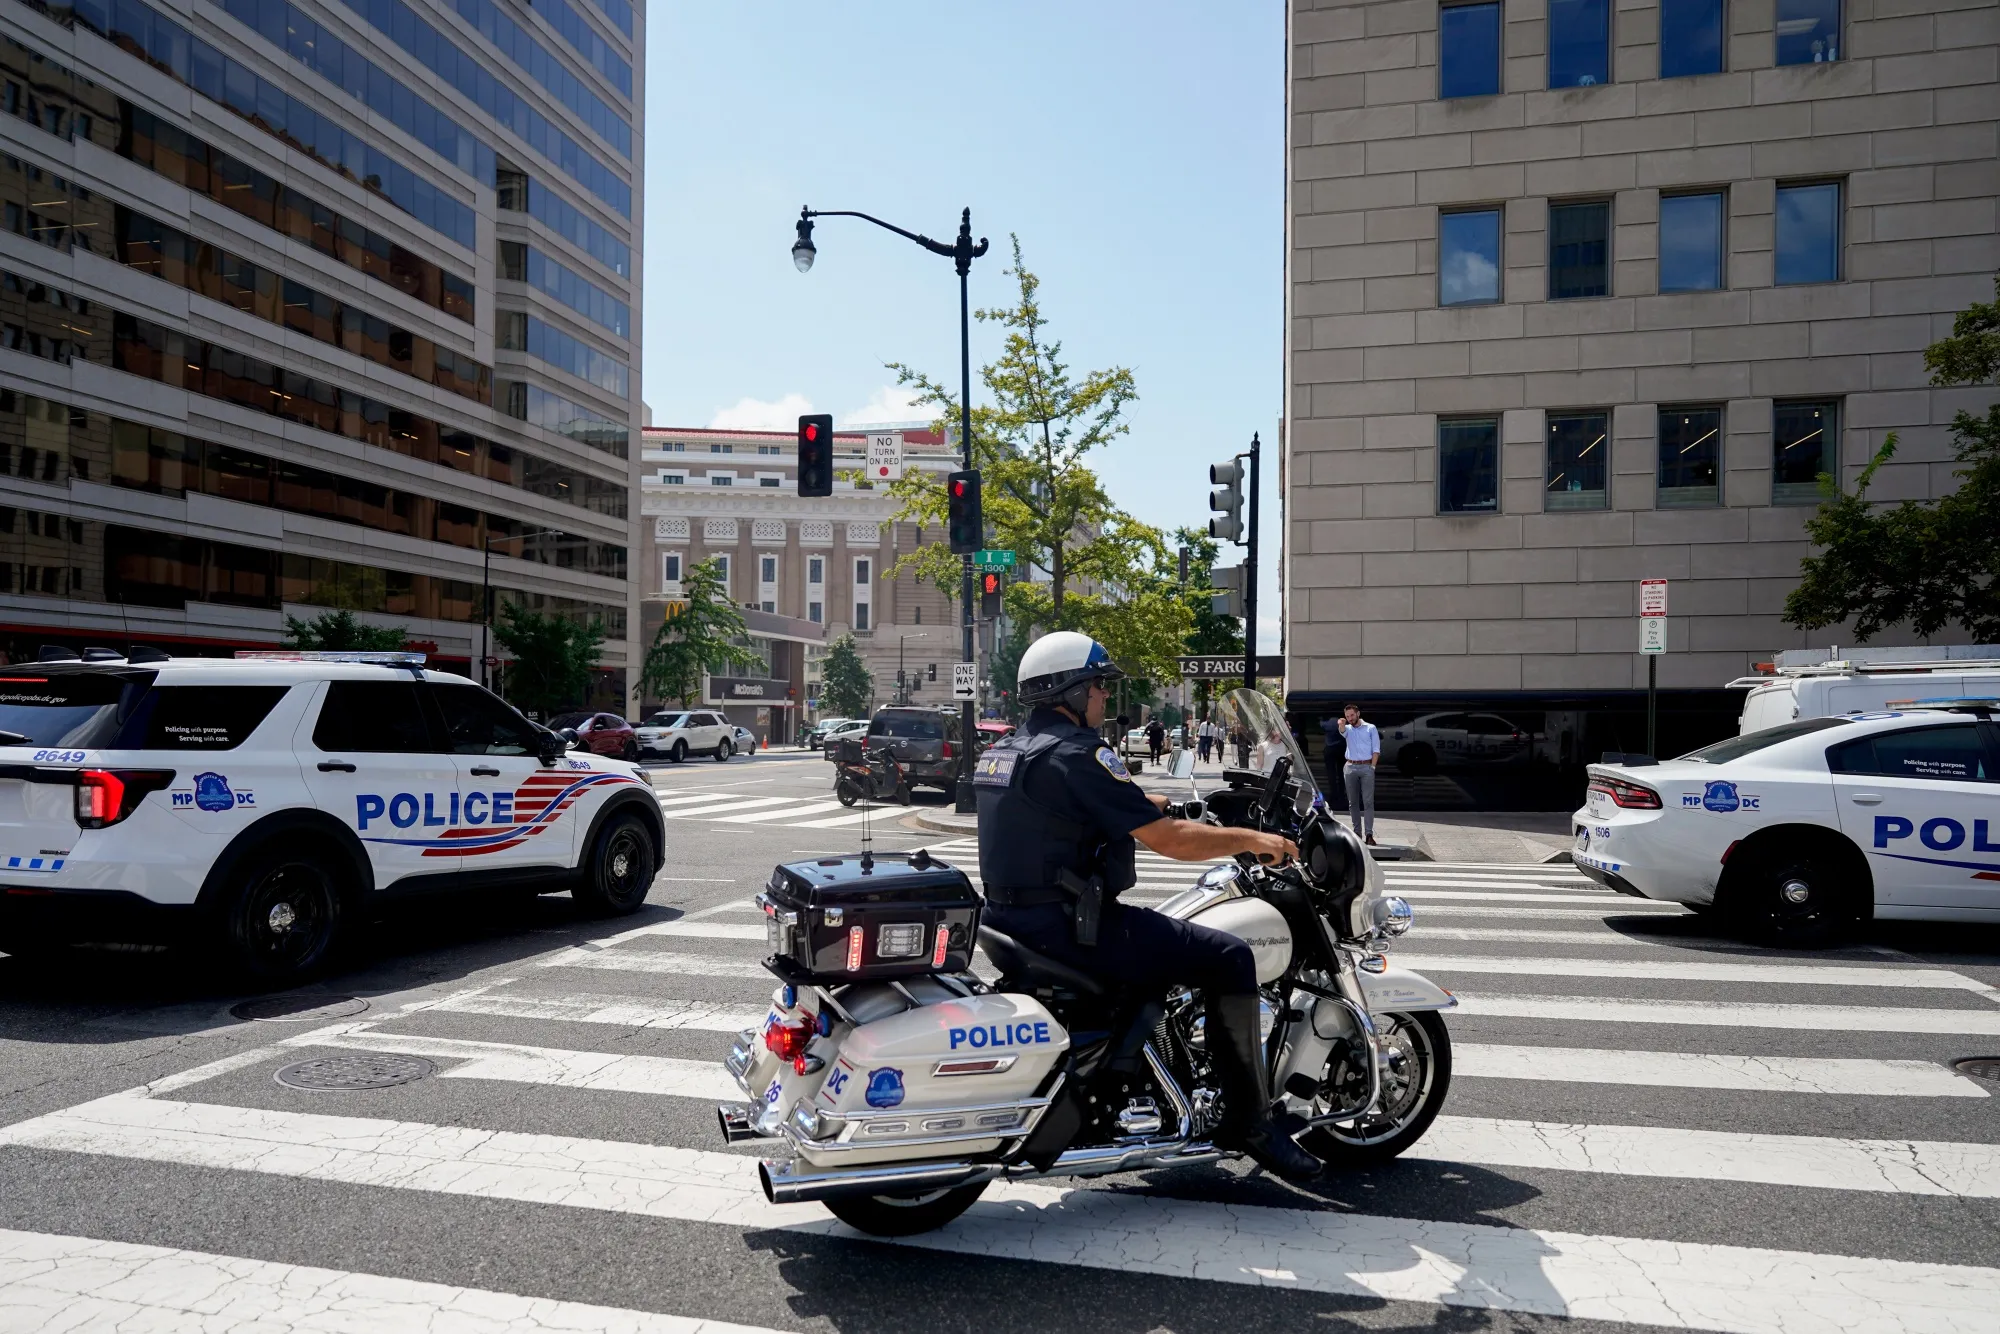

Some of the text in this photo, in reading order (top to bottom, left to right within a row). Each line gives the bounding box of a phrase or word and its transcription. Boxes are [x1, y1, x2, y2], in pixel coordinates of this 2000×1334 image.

[877, 437, 893, 446] NO
[986, 552, 993, 562] I
[984, 564, 1005, 572] 1300
[956, 665, 975, 675] ONE
[1204, 660, 1259, 673] FARG
[956, 676, 975, 685] WAY
[734, 683, 764, 695] McDonald's
[165, 725, 190, 733] Policing
[33, 750, 86, 762] 8649
[569, 760, 591, 770] 8649
[1916, 766, 1939, 774] Serving
[172, 793, 193, 805] MP
[236, 793, 255, 804] DC
[1682, 797, 1701, 805] MP
[1742, 799, 1760, 808] DC
[356, 791, 514, 830] POLICE
[1595, 826, 1611, 838] 1506
[949, 1022, 1051, 1050] POLICE
[827, 1067, 849, 1095] DC
